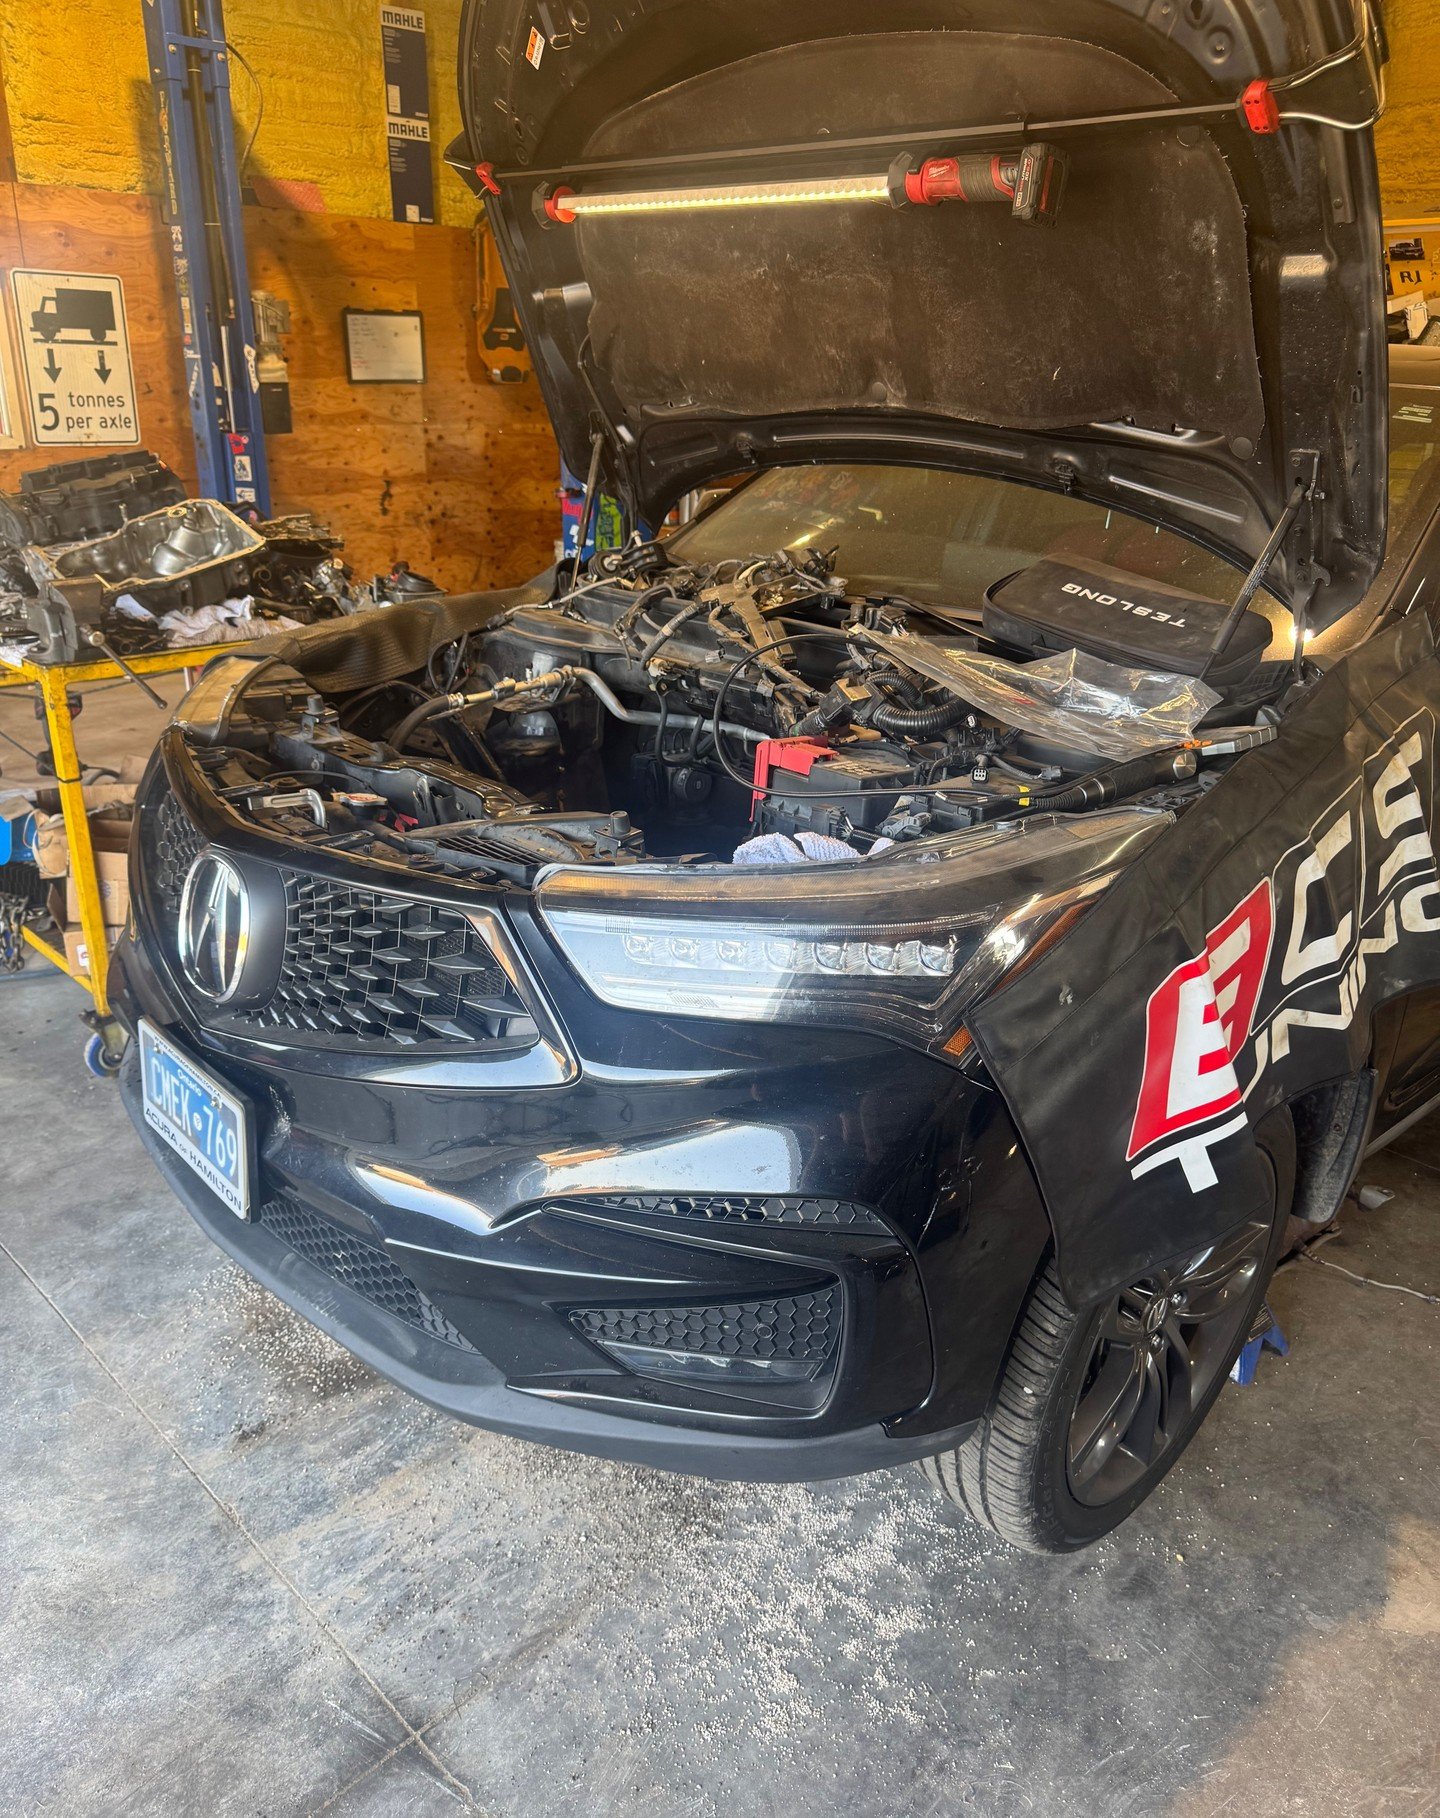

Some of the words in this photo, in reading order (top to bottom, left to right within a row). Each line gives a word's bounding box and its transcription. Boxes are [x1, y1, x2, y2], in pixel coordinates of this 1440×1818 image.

[382, 10, 424, 30] MAHLE
[388, 122, 428, 139] MAHLE
[38, 393, 60, 431] 5
[68, 391, 126, 408] tonnes
[66, 415, 93, 432] per
[99, 413, 132, 429] axle
[1061, 582, 1186, 628] TESLONG
[203, 1104, 238, 1178] 769
[145, 1107, 178, 1146] ACURA
[189, 1148, 242, 1212] HAMILTON
